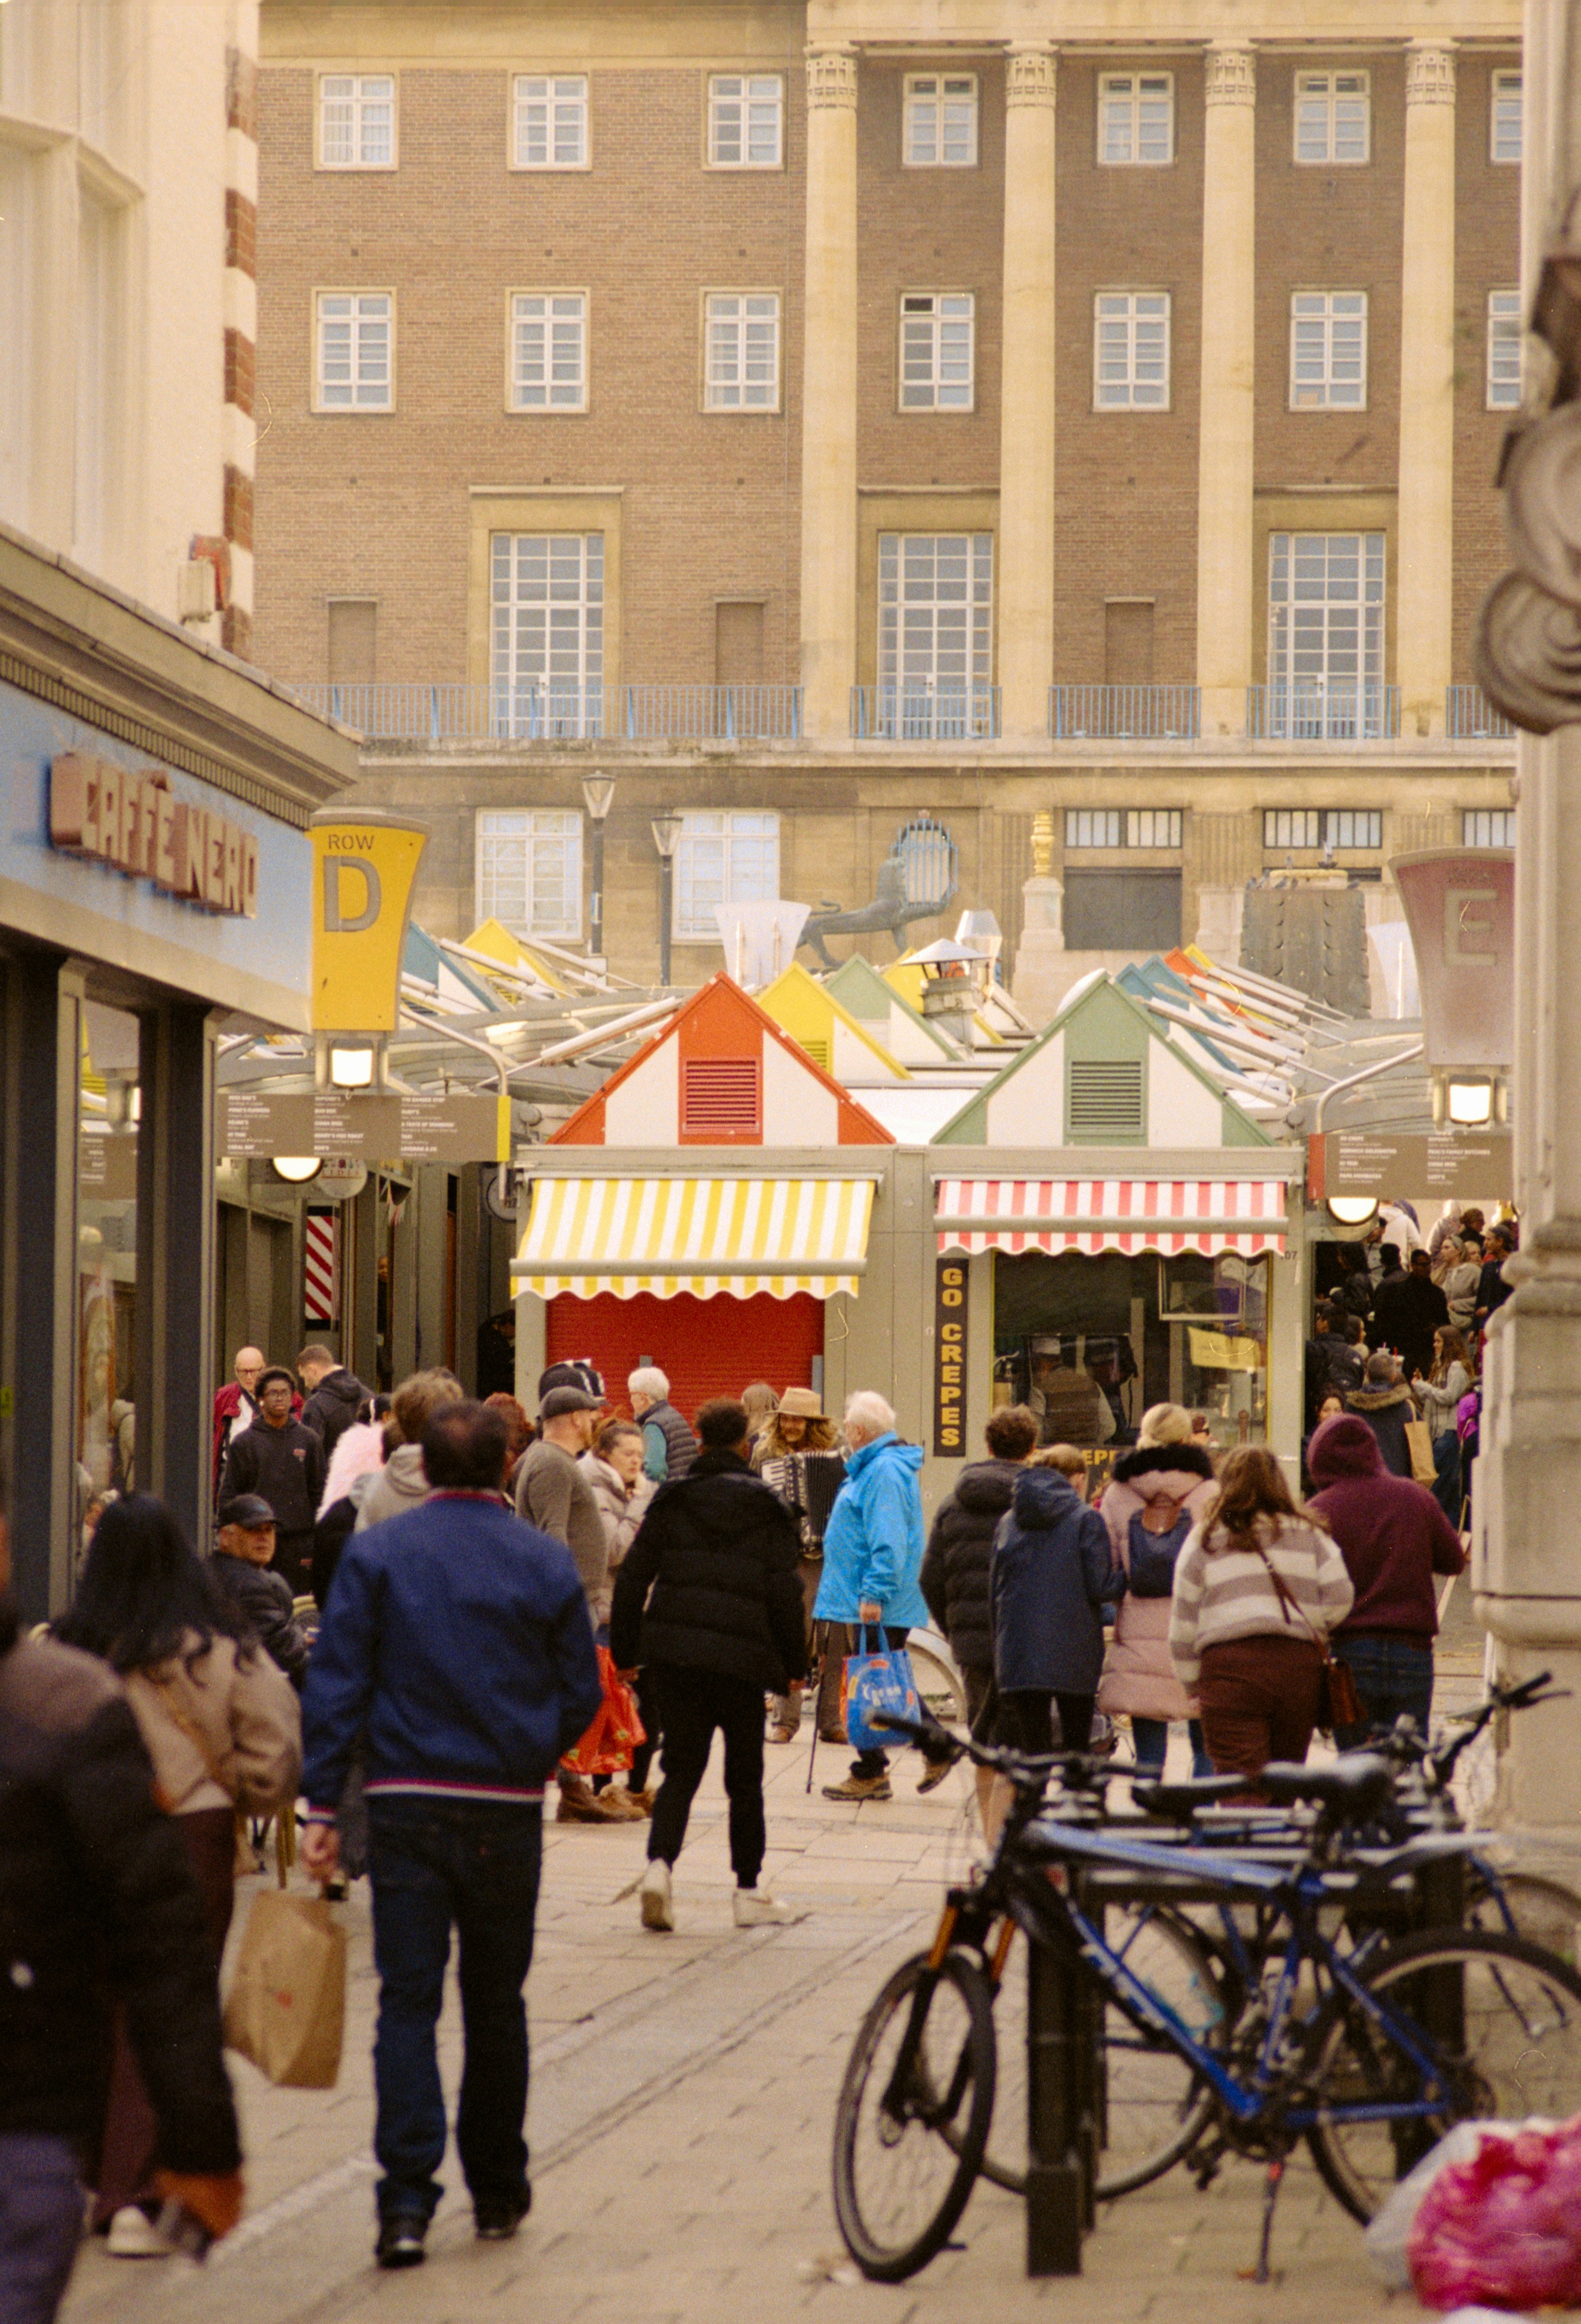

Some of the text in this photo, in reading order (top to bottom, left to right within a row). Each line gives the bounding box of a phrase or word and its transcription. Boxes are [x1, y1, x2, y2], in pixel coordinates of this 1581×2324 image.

[176, 803, 258, 919] NERO
[327, 833, 375, 850] ROW
[323, 855, 381, 933] D
[1444, 889, 1498, 966] E
[1280, 1250, 1297, 1260] 07
[940, 1267, 963, 1447] GO CREPES
